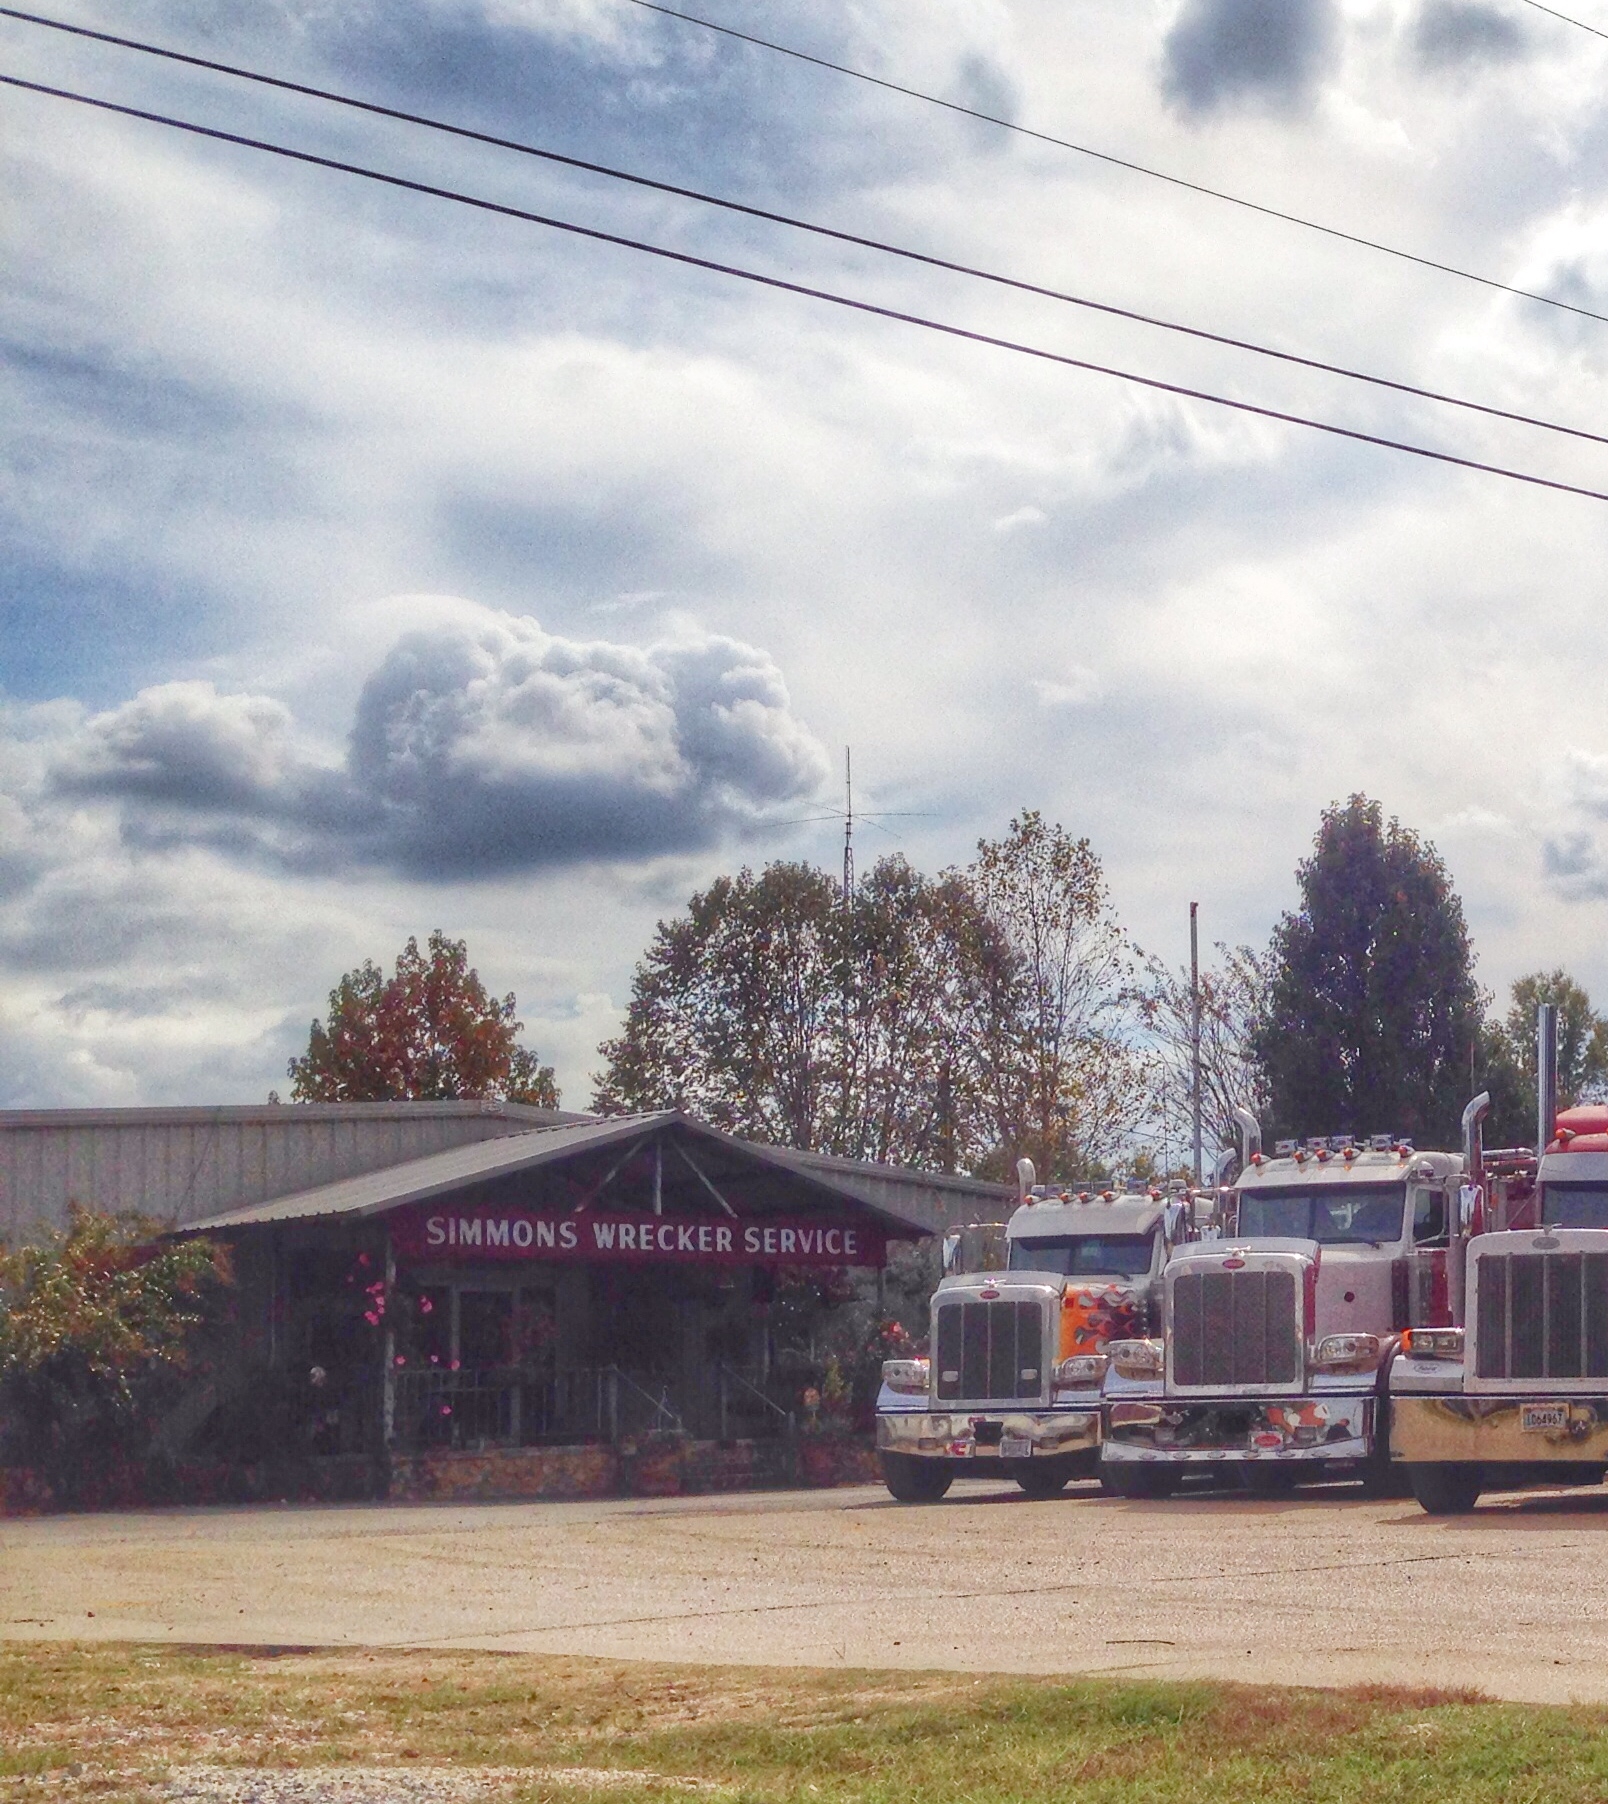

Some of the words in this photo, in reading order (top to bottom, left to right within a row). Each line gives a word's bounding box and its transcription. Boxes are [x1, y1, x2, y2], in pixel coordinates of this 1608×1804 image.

[425, 1216, 578, 1249] SIMMONS
[592, 1222, 733, 1252] WRECKER
[744, 1226, 858, 1255] SERVICE
